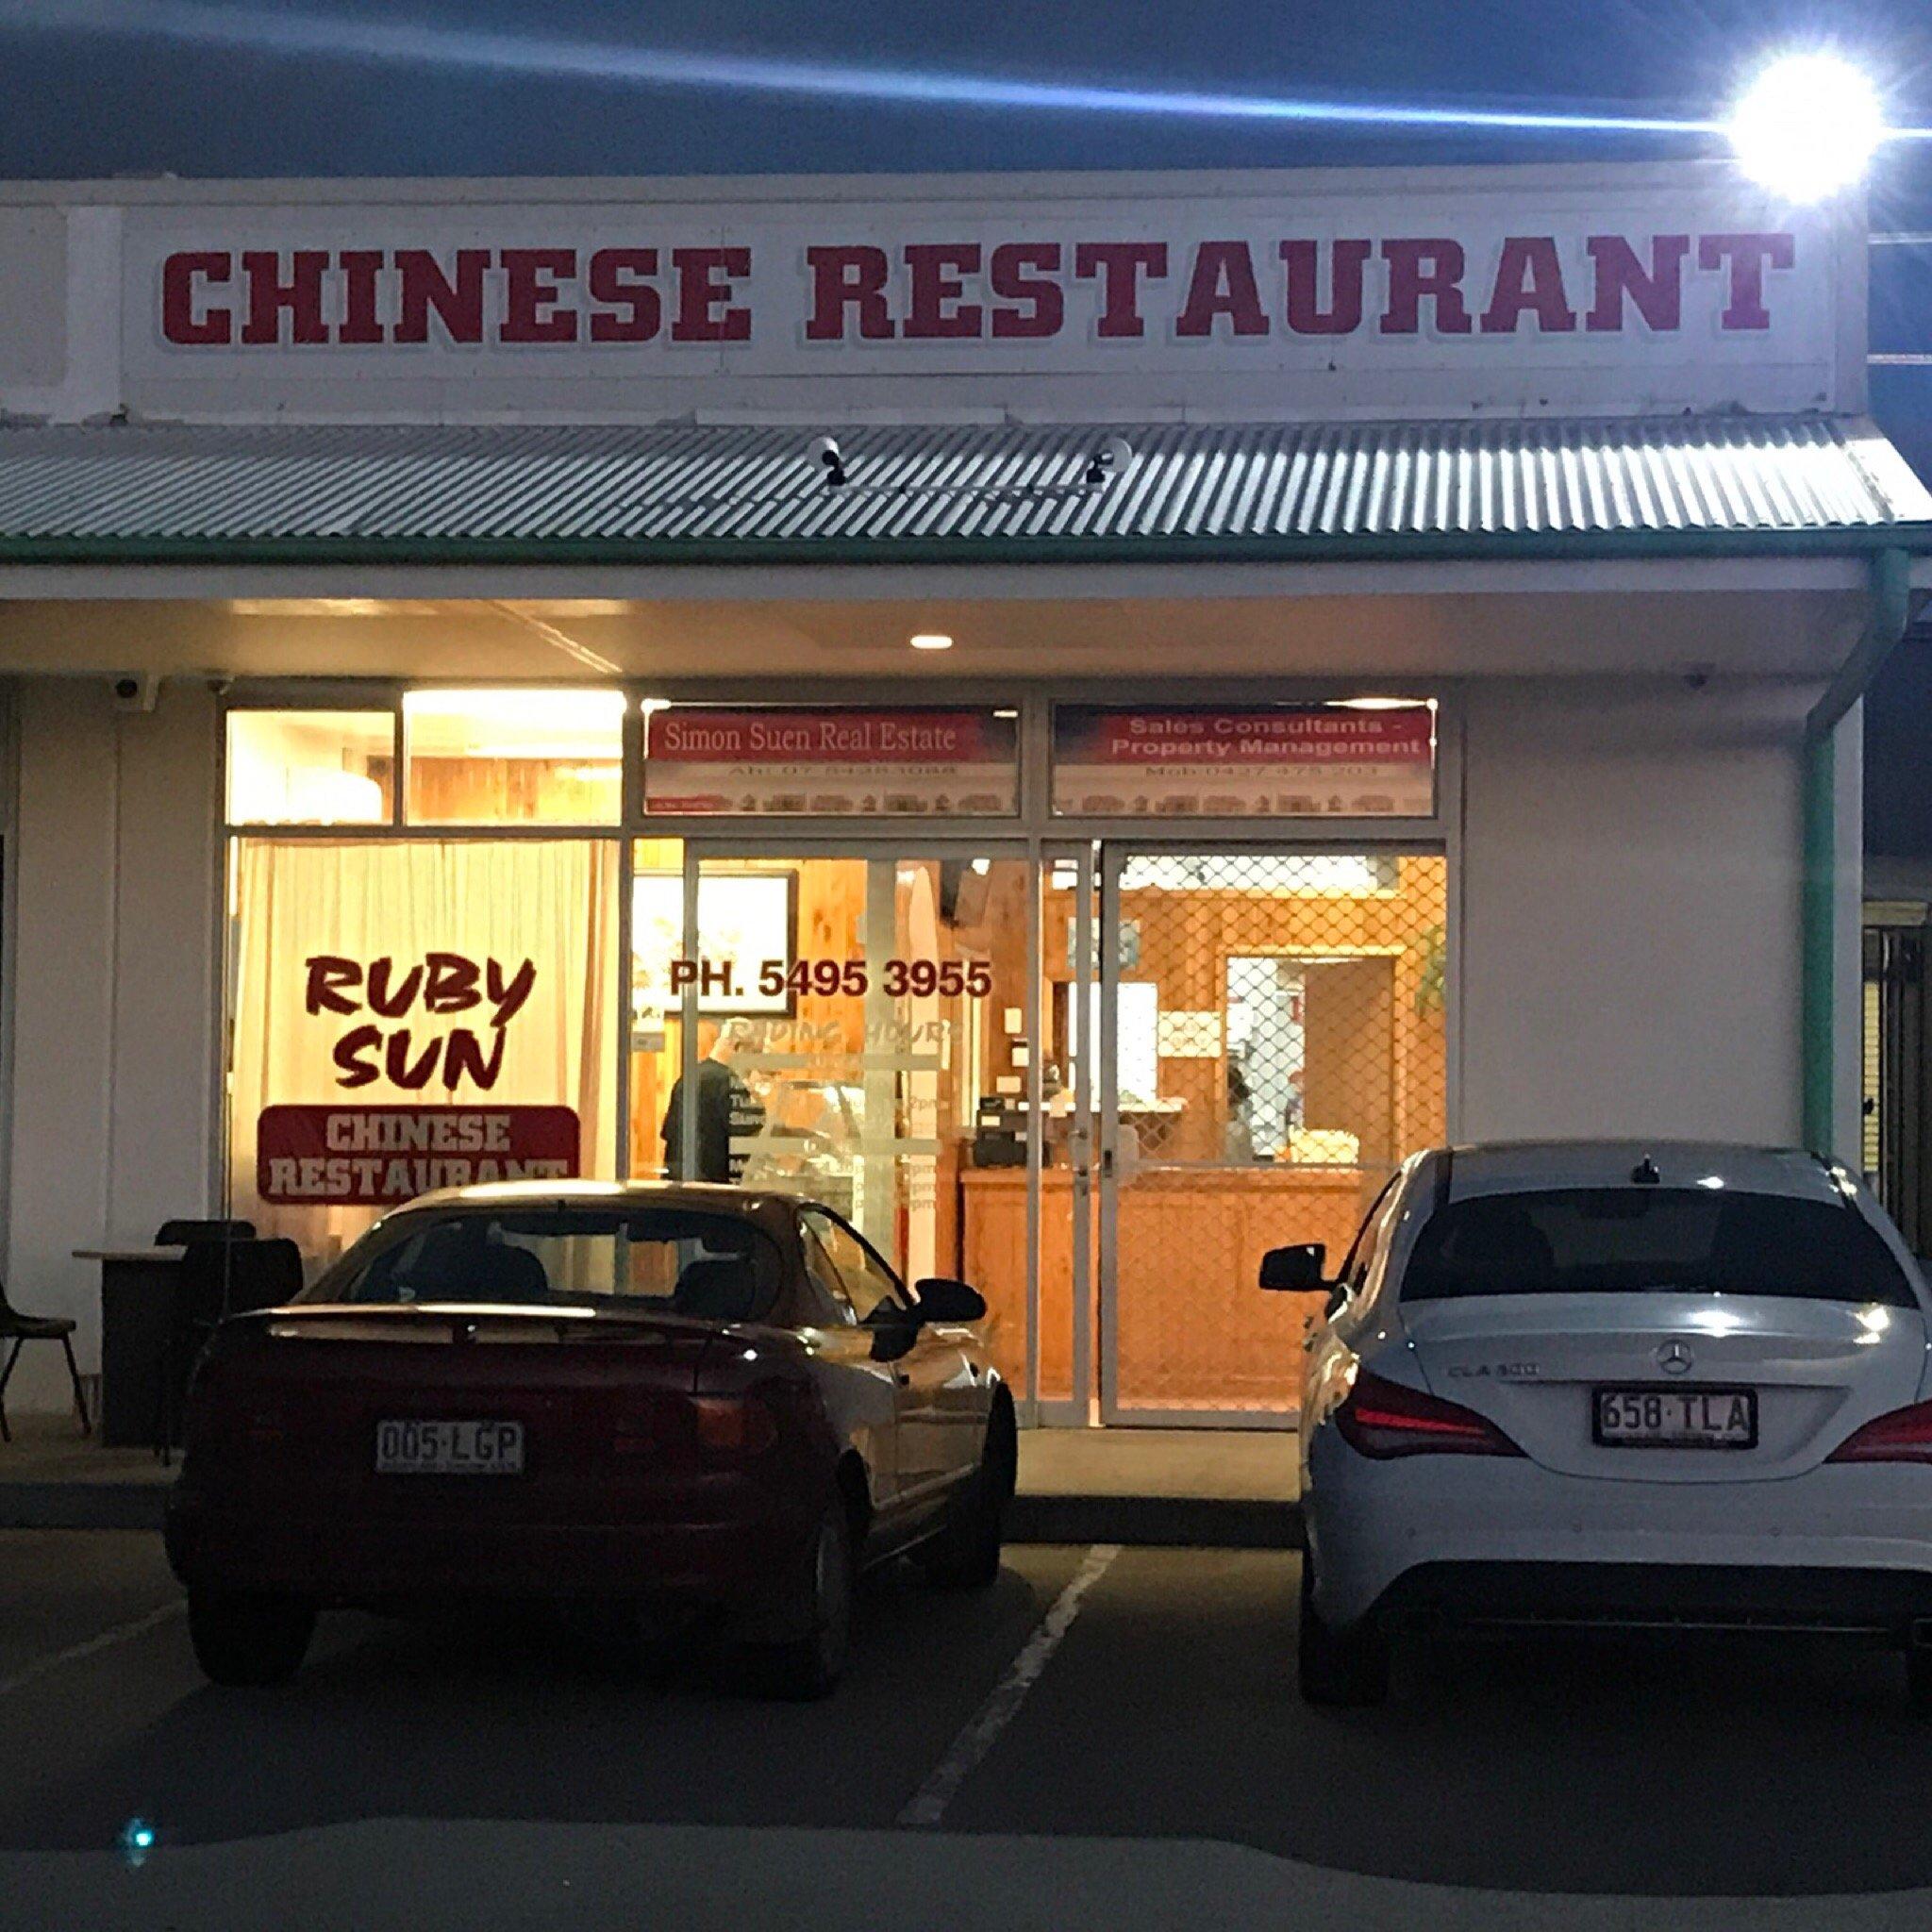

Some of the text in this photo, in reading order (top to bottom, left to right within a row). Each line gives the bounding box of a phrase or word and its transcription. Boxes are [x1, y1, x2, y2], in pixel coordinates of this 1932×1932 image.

[162, 233, 1795, 345] CHINESE RESTAURANT
[664, 722, 957, 751] Simon Suen Real Estate
[1130, 719, 1205, 734] Sales
[1213, 718, 1383, 734] Consultants
[1111, 738, 1420, 756] Property Management
[305, 951, 537, 1027] RUBY
[670, 960, 992, 997] PH. 5495 3955
[332, 1024, 507, 1091] SUN
[325, 1113, 511, 1153] CHINESE
